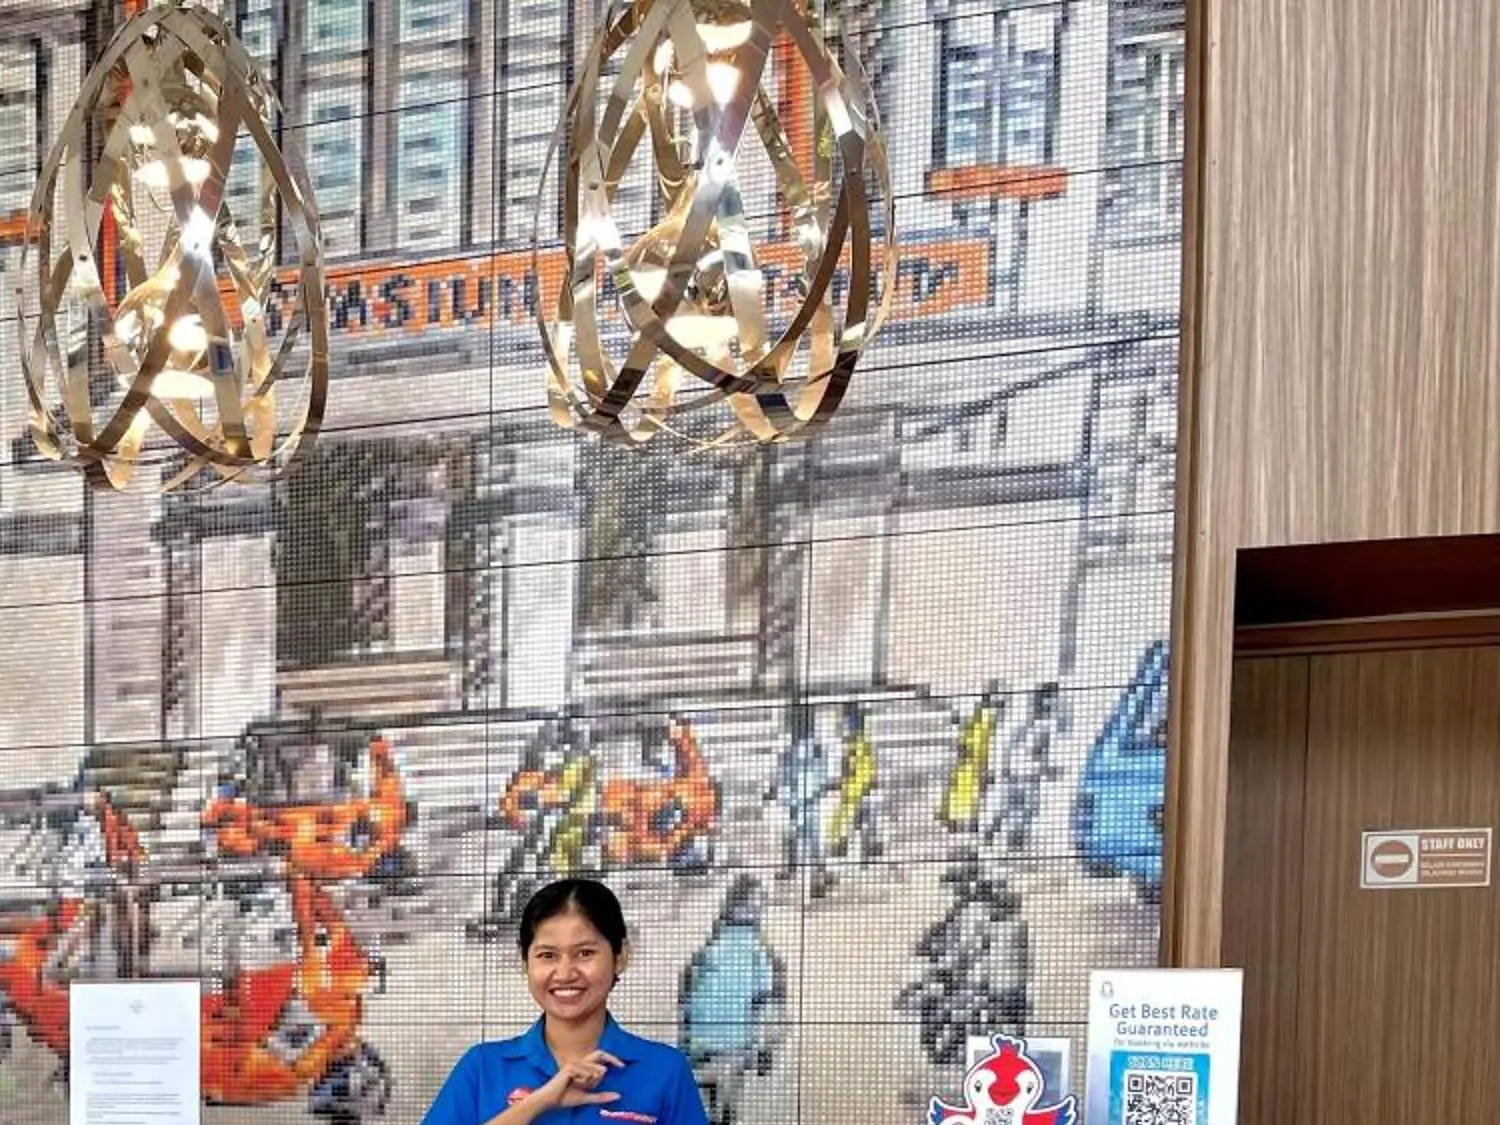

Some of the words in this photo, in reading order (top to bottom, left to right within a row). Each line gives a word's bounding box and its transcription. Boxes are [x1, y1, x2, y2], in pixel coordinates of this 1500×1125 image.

[1421, 838, 1454, 850] STAFF
[1457, 837, 1485, 849] ONLY
[1109, 1003, 1136, 1018] Get
[1141, 1003, 1176, 1019] Best
[1181, 1004, 1219, 1020] Rate
[1116, 1021, 1209, 1037] Guaranteed
